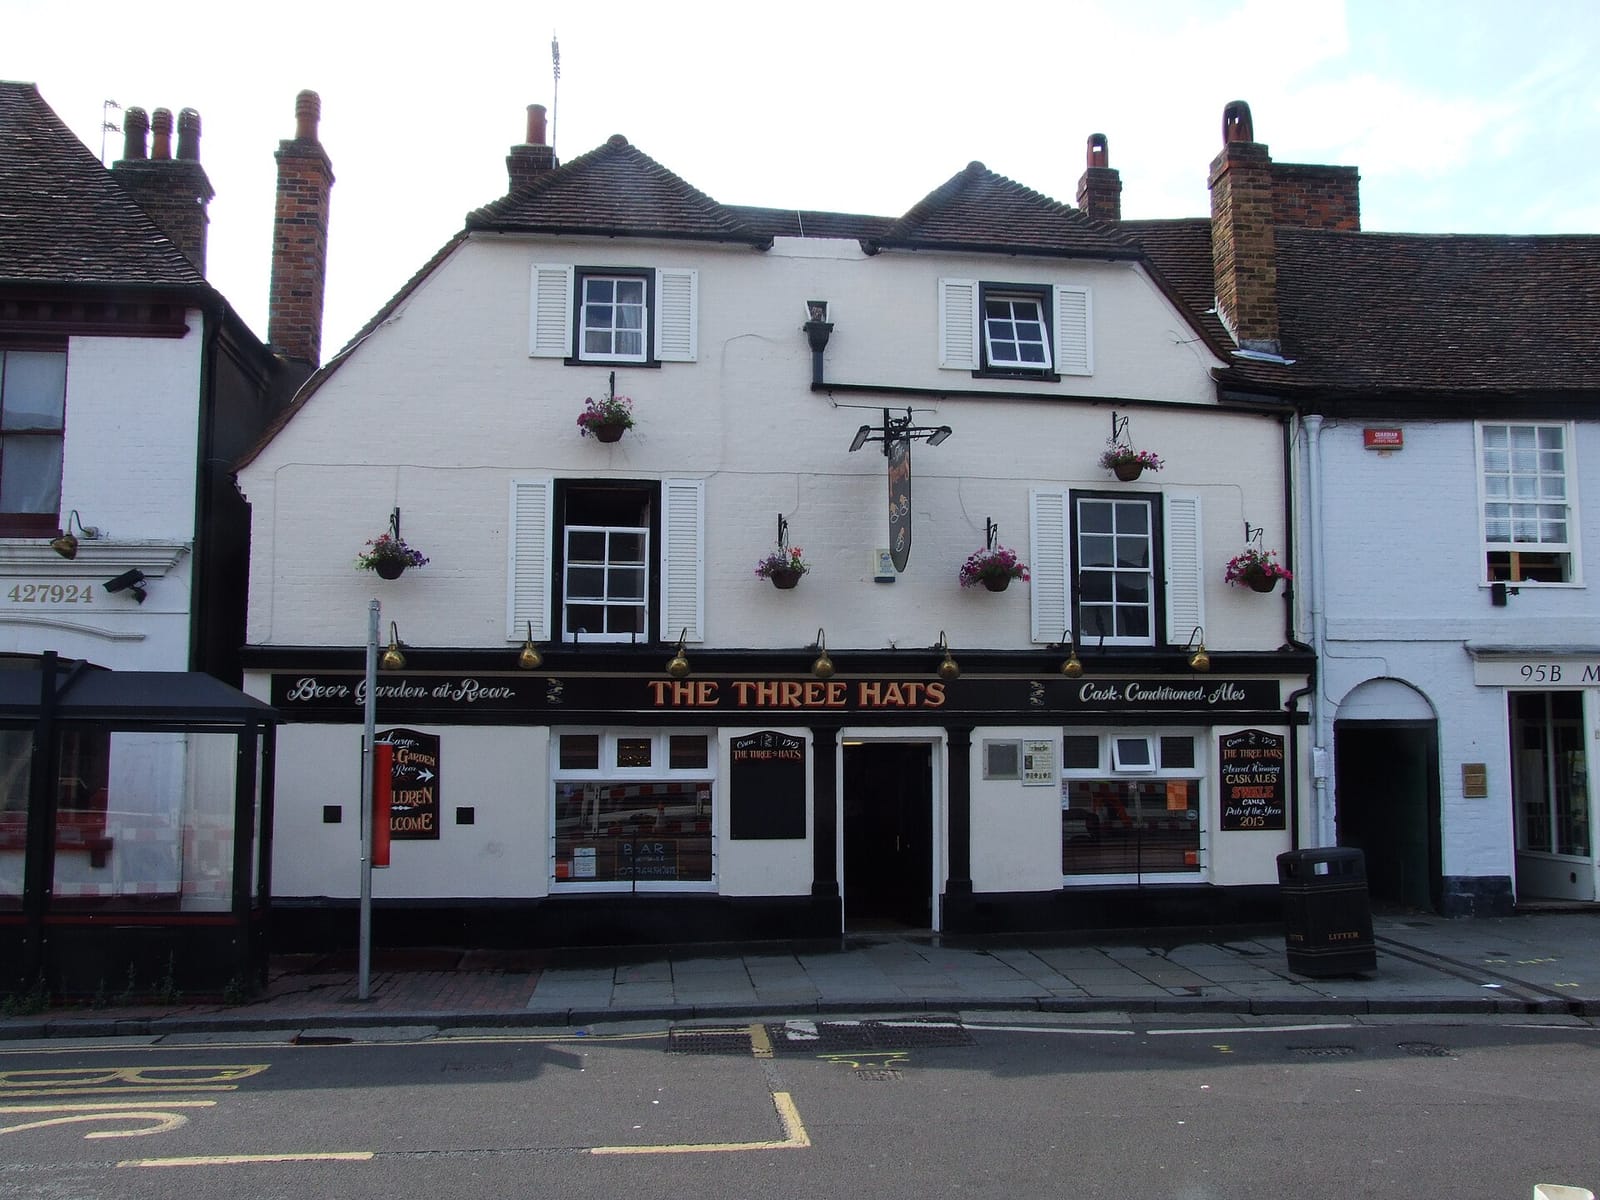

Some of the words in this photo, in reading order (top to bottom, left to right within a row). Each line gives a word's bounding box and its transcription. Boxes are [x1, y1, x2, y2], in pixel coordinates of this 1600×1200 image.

[7, 584, 94, 603] 427924
[1520, 665, 1562, 682] 95B
[287, 677, 350, 701] Beer
[431, 682, 451, 698] at
[452, 678, 515, 702] Rear
[648, 681, 719, 707] THE
[731, 681, 847, 707] THREE
[858, 682, 946, 707] HATS
[1079, 682, 1122, 703] Cask
[1124, 682, 1206, 702] Conditioned
[1208, 682, 1246, 704] Ales
[733, 749, 749, 760] THE
[750, 749, 772, 760] THREE
[778, 749, 802, 760] HATS
[1223, 749, 1238, 760] THE
[1240, 749, 1262, 760] THREE
[1263, 749, 1283, 760] HATS
[1225, 774, 1252, 784] CASK
[1252, 774, 1277, 783] ALES
[391, 787, 433, 806] LDREN
[1225, 806, 1242, 817] Pub
[390, 813, 433, 831] LCOME
[1240, 816, 1265, 827] 2013
